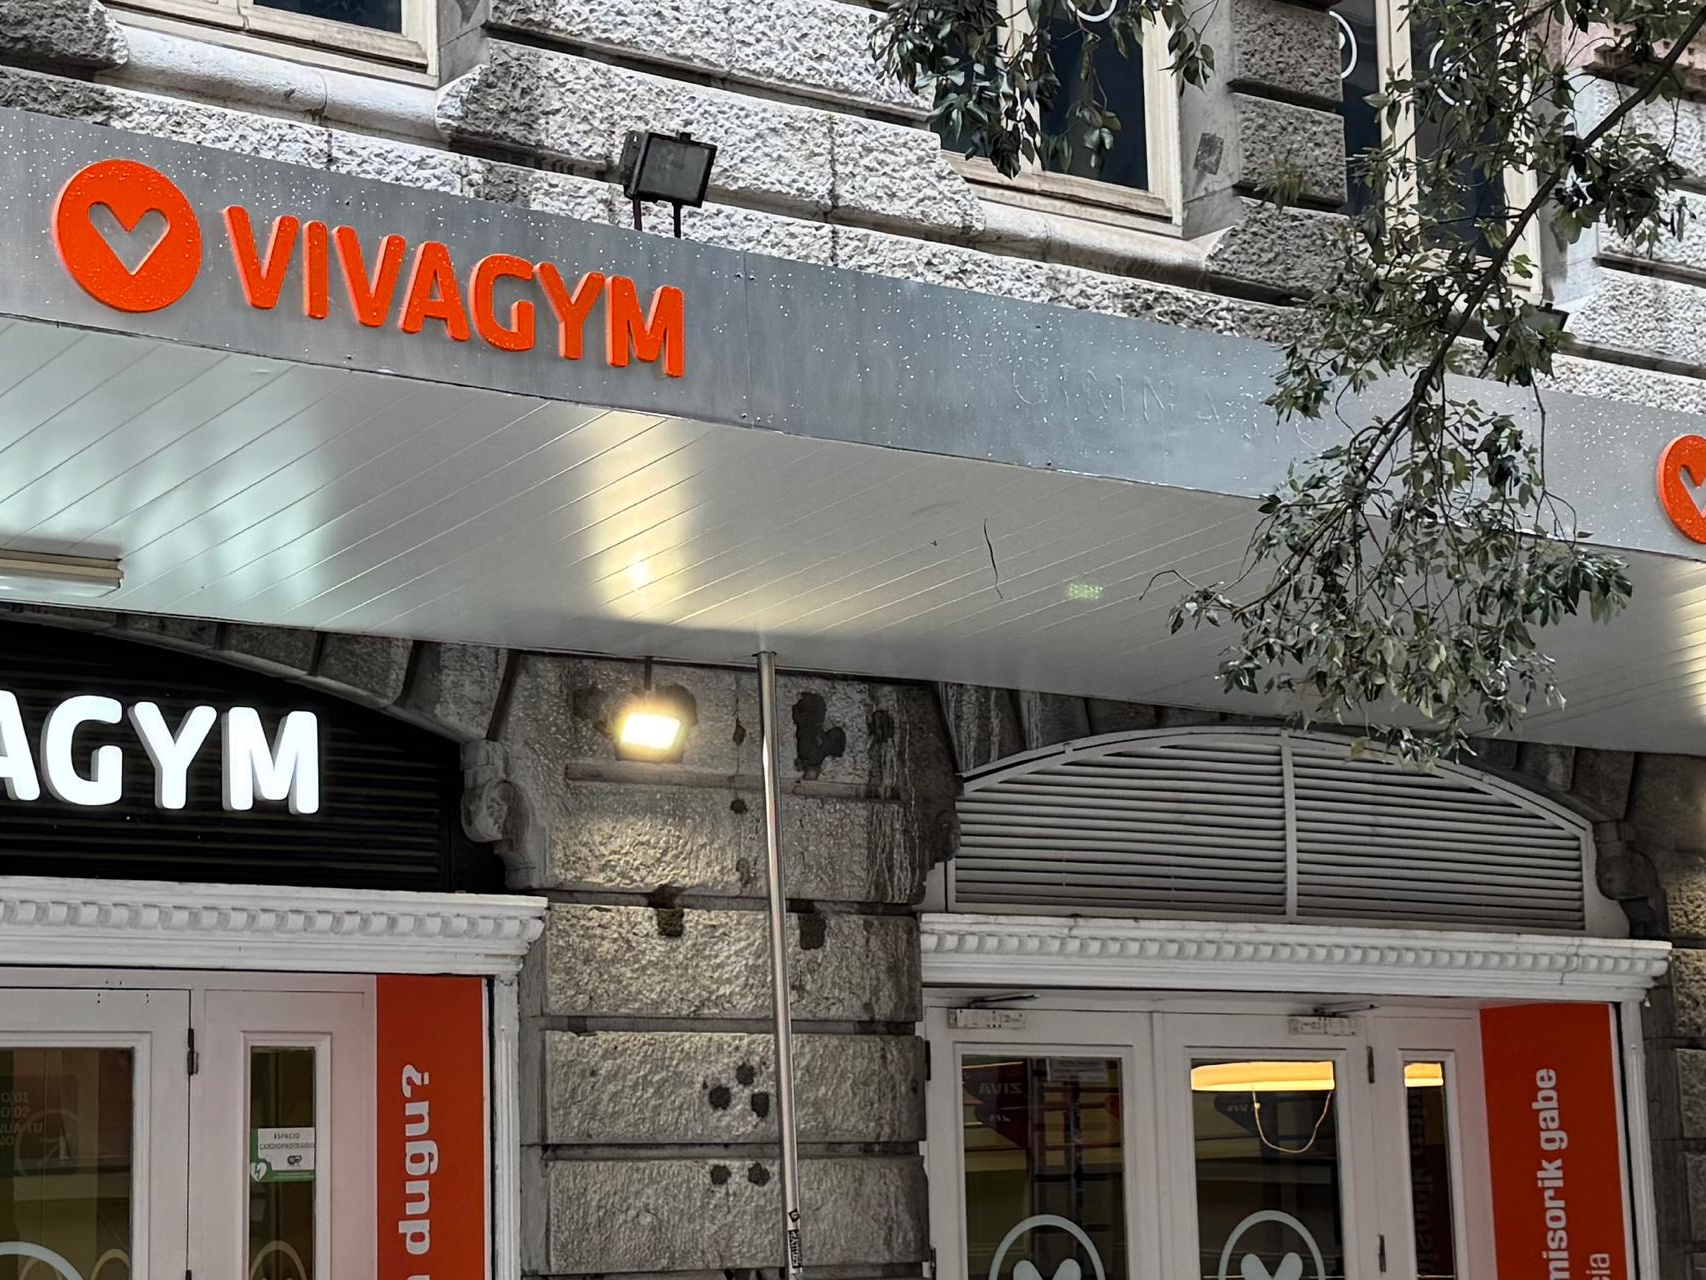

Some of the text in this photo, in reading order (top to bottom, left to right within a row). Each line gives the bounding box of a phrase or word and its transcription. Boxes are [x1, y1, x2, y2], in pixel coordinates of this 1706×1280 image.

[222, 205, 686, 379] VIVAGYM
[399, 1063, 439, 1256] dugu?
[1532, 1068, 1569, 1151] gabe
